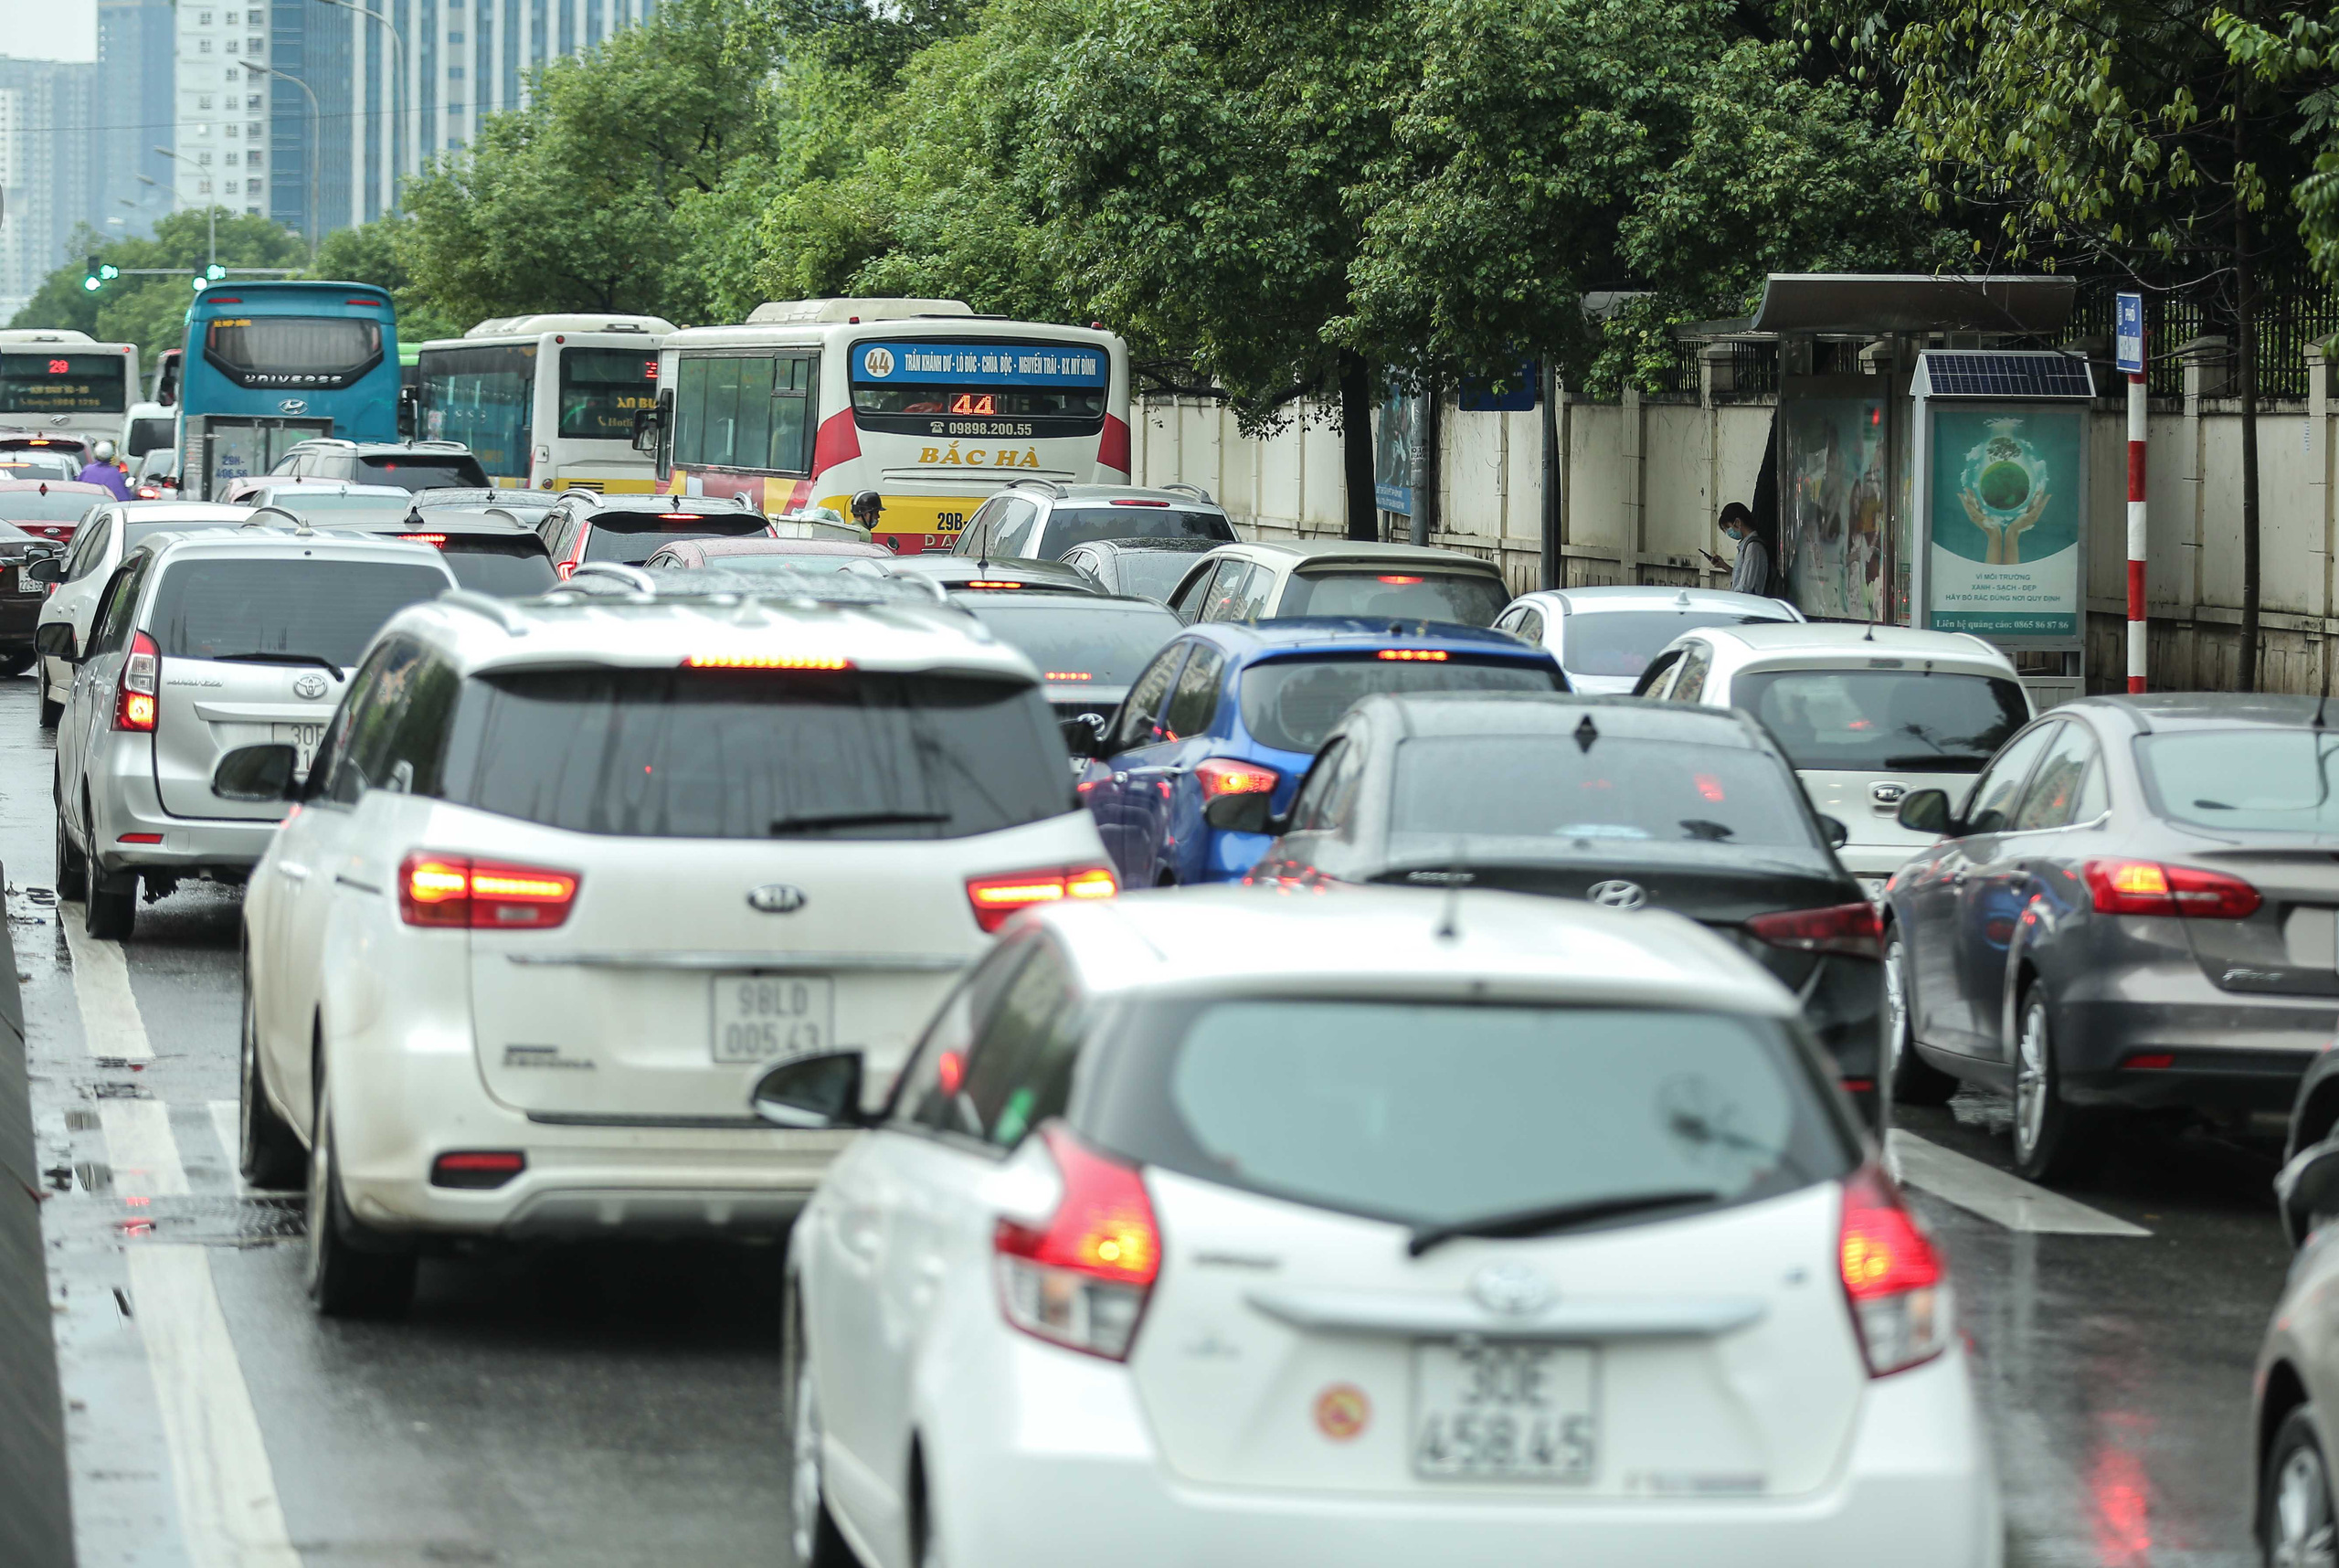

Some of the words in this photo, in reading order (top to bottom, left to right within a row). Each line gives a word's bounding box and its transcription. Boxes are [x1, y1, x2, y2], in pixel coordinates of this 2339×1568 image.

[48, 359, 69, 374] 29
[867, 352, 890, 374] 44
[905, 348, 921, 371] TRẦN
[921, 351, 942, 372] KHÁNH
[943, 354, 953, 372] DƯ
[956, 352, 964, 373] LÒ
[965, 352, 978, 373] ĐÚC
[981, 352, 999, 373] CHÙA
[1000, 352, 1012, 376] BỘC
[1019, 352, 1042, 374] NGUYỄN
[1043, 355, 1057, 375] TRÃI
[1062, 357, 1070, 375] BX
[1070, 355, 1081, 376] MỸ
[1081, 355, 1096, 376] ĐÌNH
[244, 374, 343, 384] UNIVERSE
[639, 397, 657, 408] BU
[952, 393, 995, 415] 44
[609, 418, 633, 427] Hotli
[948, 422, 1032, 435] 09898.200.55
[918, 440, 987, 466] BẮC
[994, 446, 1041, 468] HÀ
[1999, 573, 2031, 581] TRƯỜNG
[1936, 620, 1954, 628] Liên
[1957, 620, 1965, 630] hệ
[1967, 620, 1994, 630] quảng
[1995, 620, 2012, 629] cáo:
[2014, 620, 2033, 629] 0865
[2036, 620, 2046, 630] 86
[2047, 620, 2057, 630] 87
[2058, 620, 2069, 630] 86
